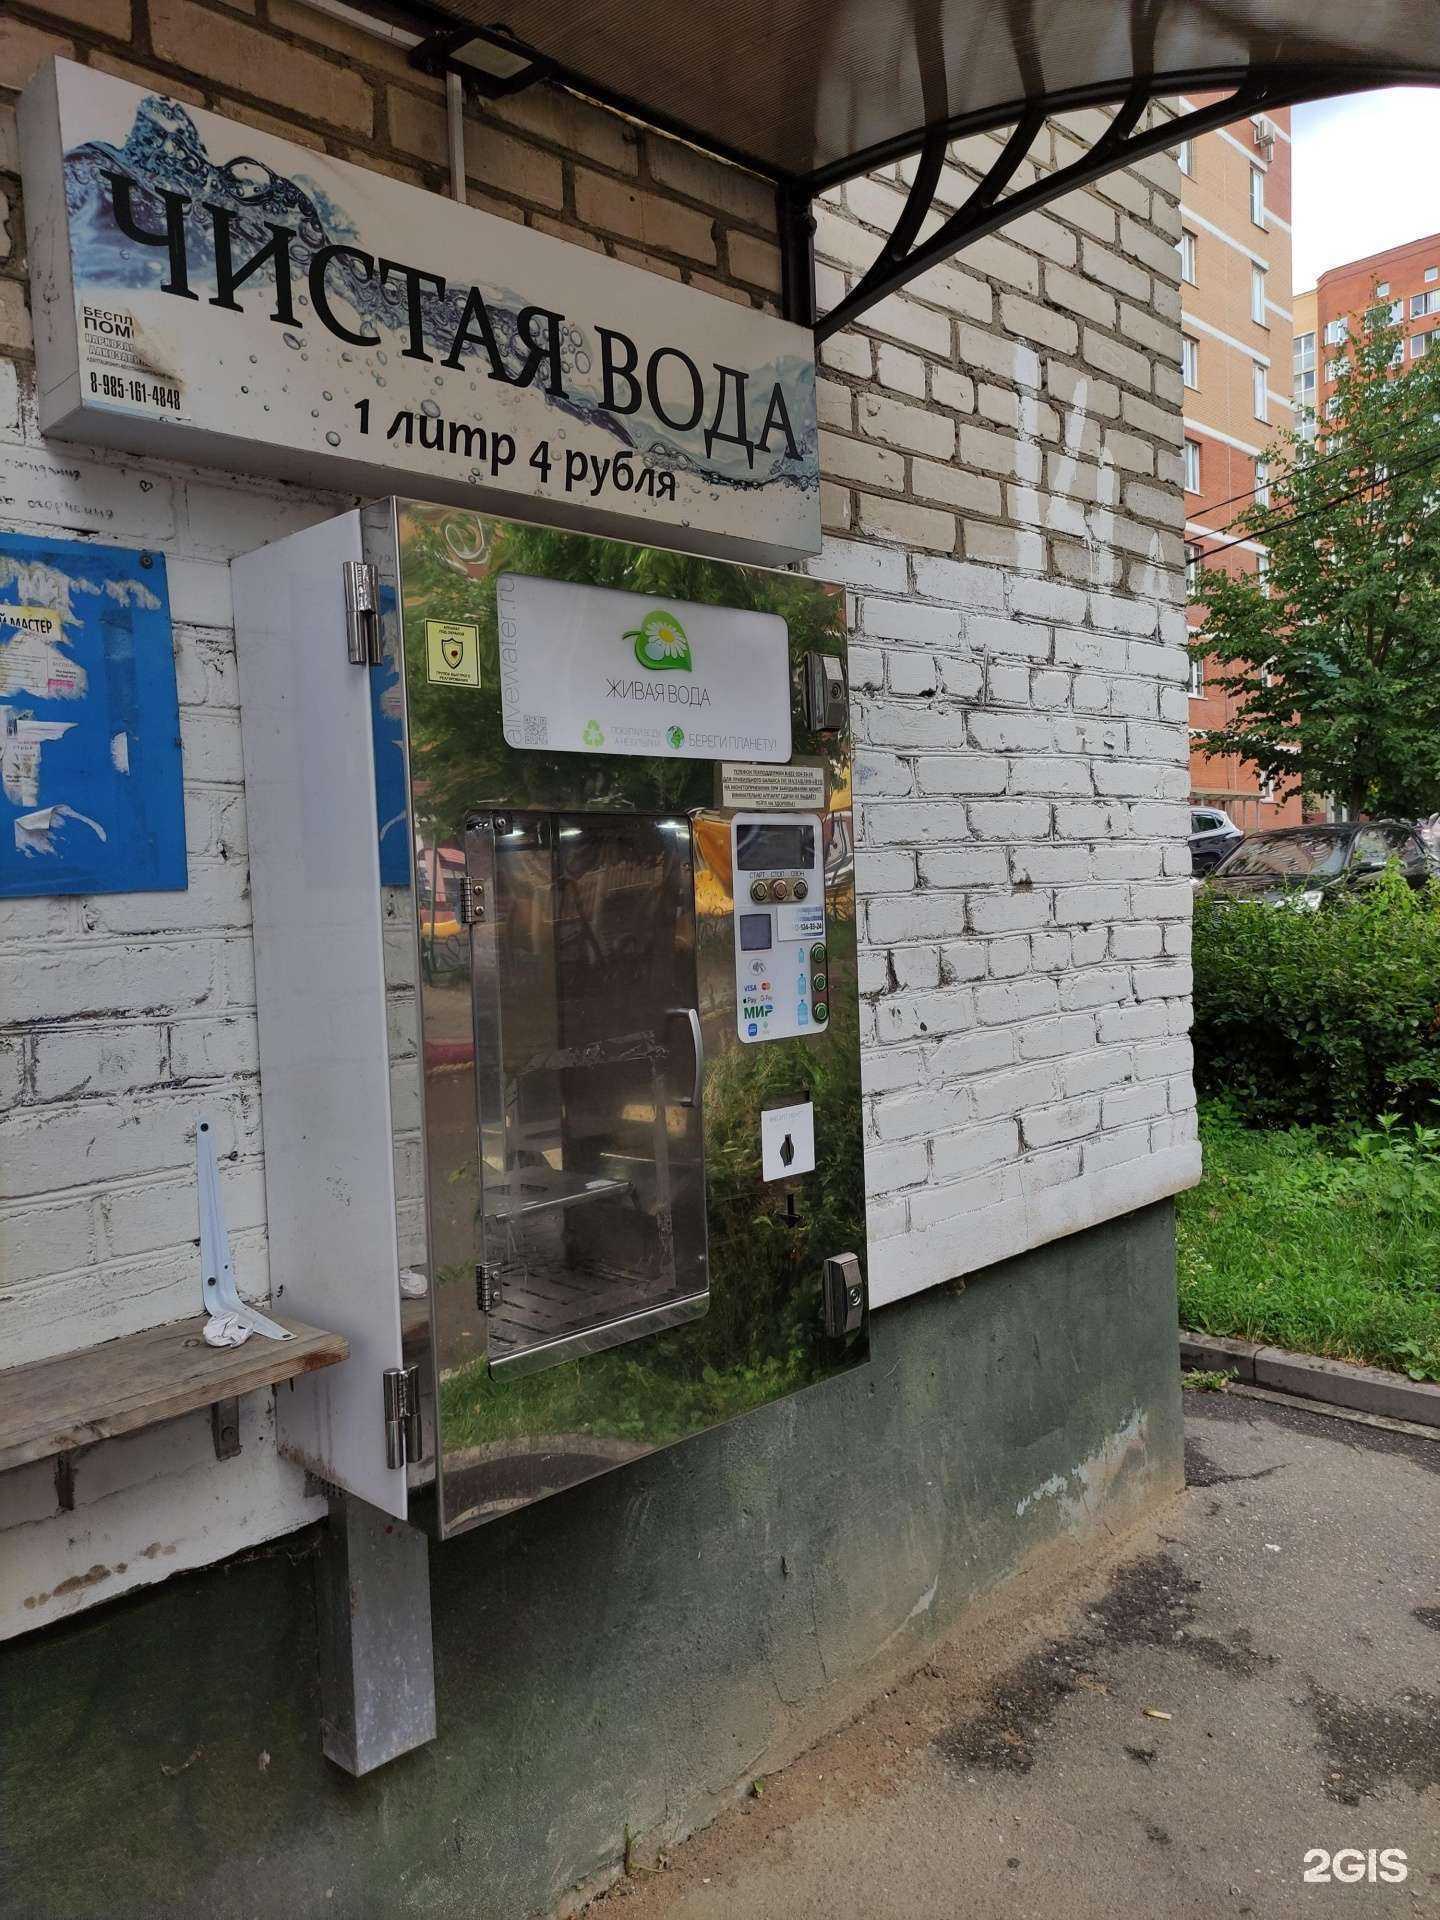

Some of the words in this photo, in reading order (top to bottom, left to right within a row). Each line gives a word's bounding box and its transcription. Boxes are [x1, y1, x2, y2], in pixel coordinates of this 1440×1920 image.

[84, 316, 135, 339] ПОМ
[101, 169, 566, 399] ЧИСТАЯ
[594, 325, 804, 469] ВОДА
[90, 372, 181, 411] 8-985-161-4848
[354, 399, 369, 434] 1
[386, 411, 516, 476] литр
[529, 441, 551, 483] 4
[565, 449, 676, 501] рубля
[10, 617, 53, 634] МАСТЕР
[606, 678, 665, 702] ЖИВАЯ
[668, 684, 711, 708] ВОДА
[689, 733, 728, 748] БЕРЕГИ
[744, 984, 757, 992] VISA
[744, 1004, 773, 1019] МИР
